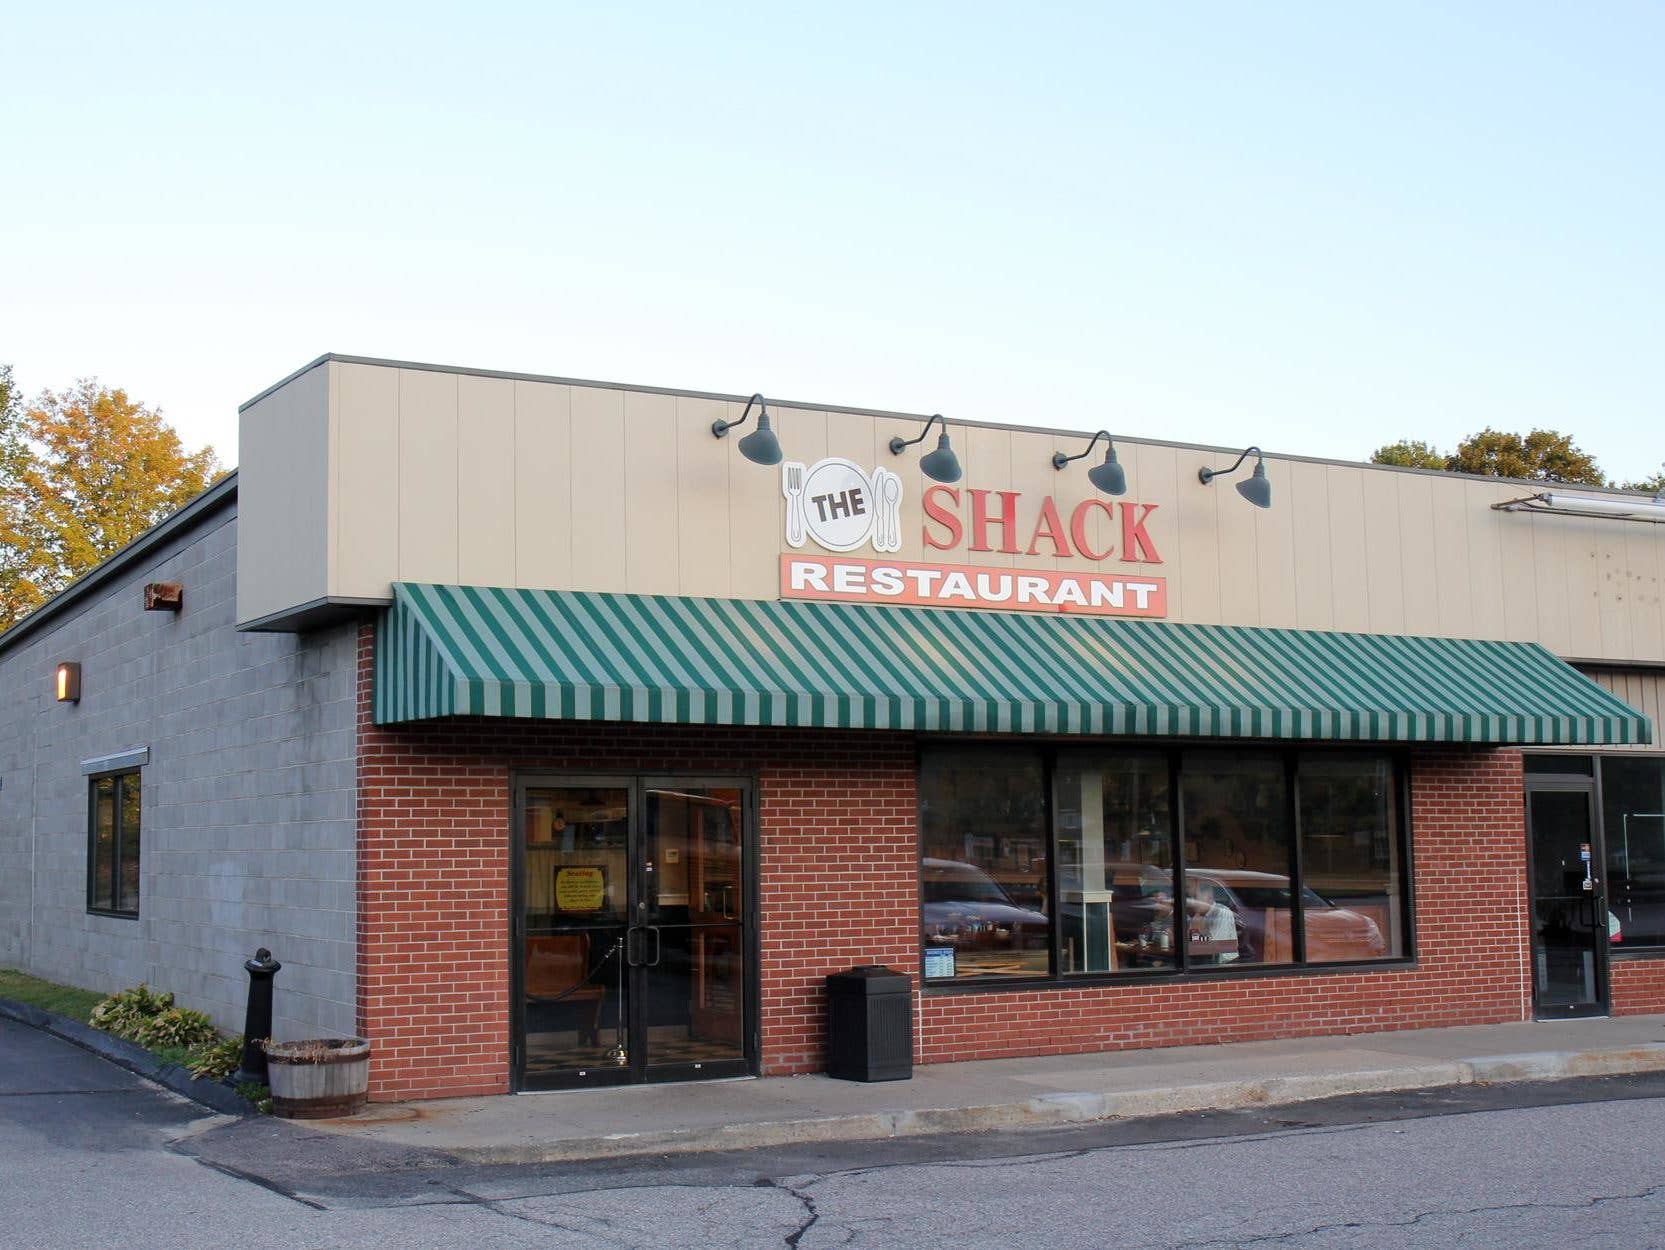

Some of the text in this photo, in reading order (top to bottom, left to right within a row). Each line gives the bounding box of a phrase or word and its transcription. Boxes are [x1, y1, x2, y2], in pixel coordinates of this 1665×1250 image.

[811, 484, 1164, 563] THE SHACK
[790, 562, 1158, 609] RESTAURANT
